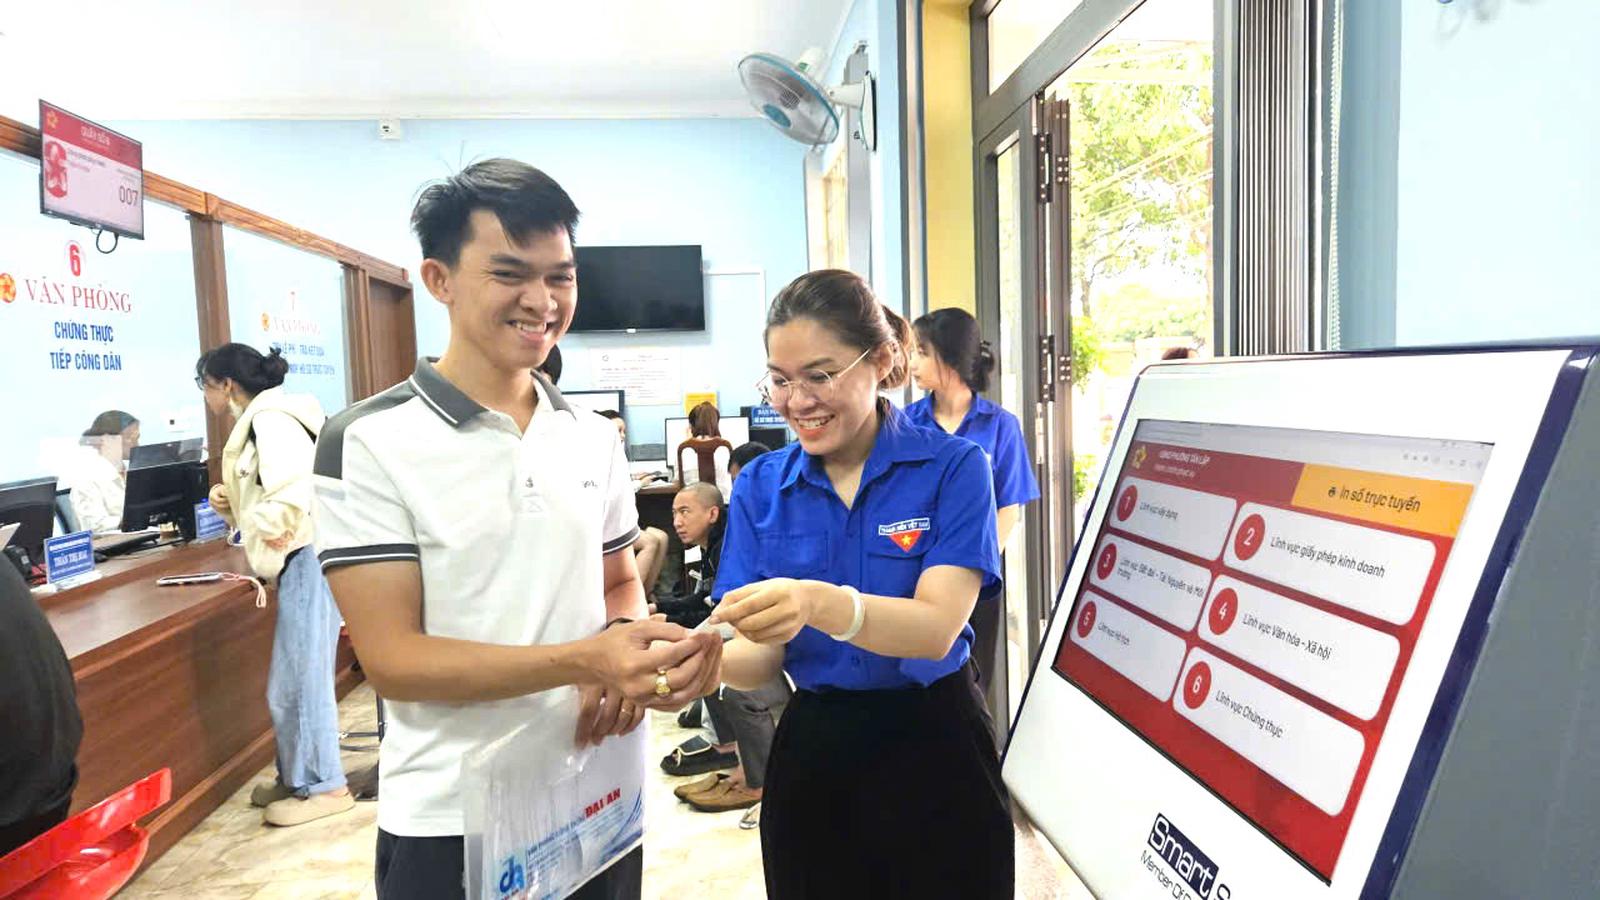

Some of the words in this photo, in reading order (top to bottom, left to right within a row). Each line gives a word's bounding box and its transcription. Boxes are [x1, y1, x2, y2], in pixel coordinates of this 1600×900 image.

[119, 185, 139, 206] 007
[69, 244, 81, 277] 6
[24, 276, 66, 305] VĂN
[72, 283, 132, 313] PHÒNG
[54, 319, 88, 341] CHỨNG
[89, 323, 114, 346] THỰC
[49, 347, 72, 370] TIẾP
[74, 349, 101, 371] CÔNG
[103, 350, 122, 371] DÂN
[1350, 487, 1364, 502] số
[1364, 491, 1388, 508] trực
[1388, 494, 1421, 513] tuyến
[1244, 527, 1256, 546] 2
[1103, 553, 1111, 568] 3
[1270, 535, 1287, 550] Lĩnh
[1286, 541, 1301, 554] vực
[1299, 544, 1317, 560] giấy
[1316, 549, 1338, 567] phép
[1337, 552, 1356, 570] kinh
[1356, 560, 1386, 578] doanh
[1083, 611, 1091, 627] 5
[1219, 601, 1228, 621] 4
[1242, 613, 1259, 629] Lĩnh
[1258, 620, 1272, 635] vực
[1271, 623, 1287, 640] Văn
[1286, 630, 1301, 647] hóa
[1304, 639, 1319, 655] Xã
[1318, 643, 1333, 661] hội
[1192, 675, 1202, 694] 6
[1215, 689, 1231, 707] Lĩnh
[1230, 699, 1244, 714] vực
[1242, 705, 1266, 730] Chứng
[1265, 719, 1284, 738] thực
[1151, 815, 1214, 896] Smart
[1140, 849, 1174, 891] Member
